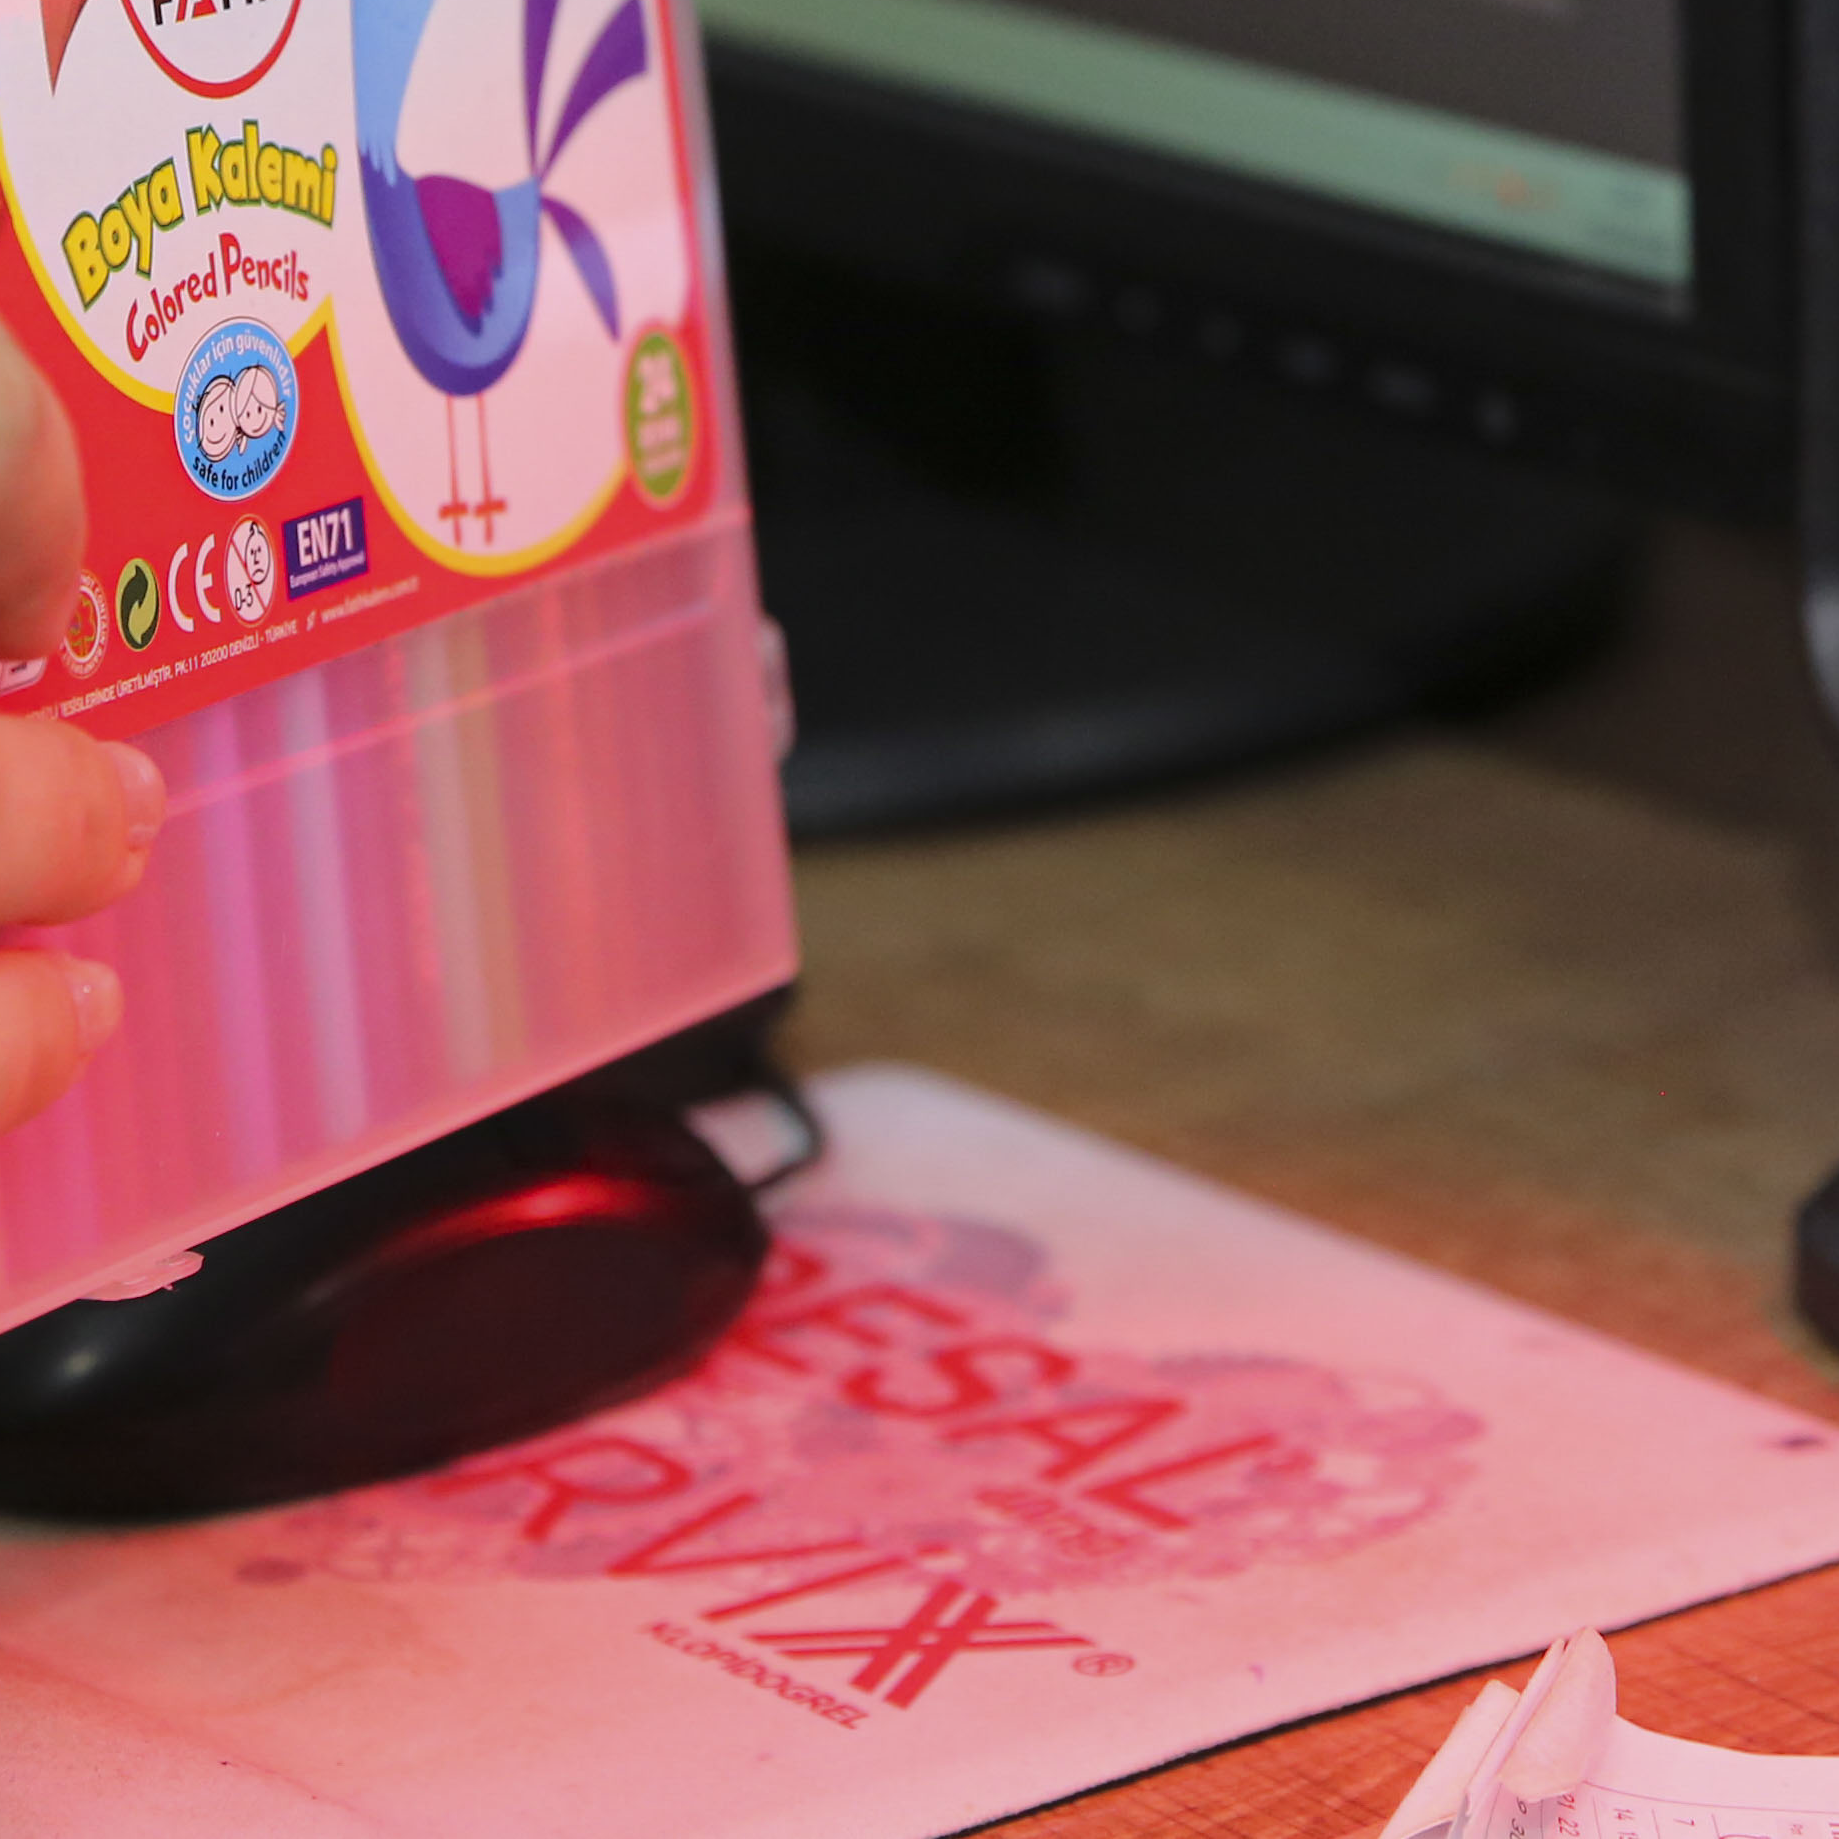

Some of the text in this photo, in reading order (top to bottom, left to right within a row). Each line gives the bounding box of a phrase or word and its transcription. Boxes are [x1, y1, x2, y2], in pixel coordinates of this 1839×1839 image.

[61, 119, 338, 312] Boya Kalemi
[126, 232, 309, 362] Colored Pencils
[183, 330, 292, 444] çocuklar için güvenlidir
[192, 431, 286, 490] safe for children
[296, 507, 354, 568] EN71
[235, 582, 254, 611] 0-3
[200, 647, 229, 668] 20200
[721, 1244, 1278, 1533] ESAL
